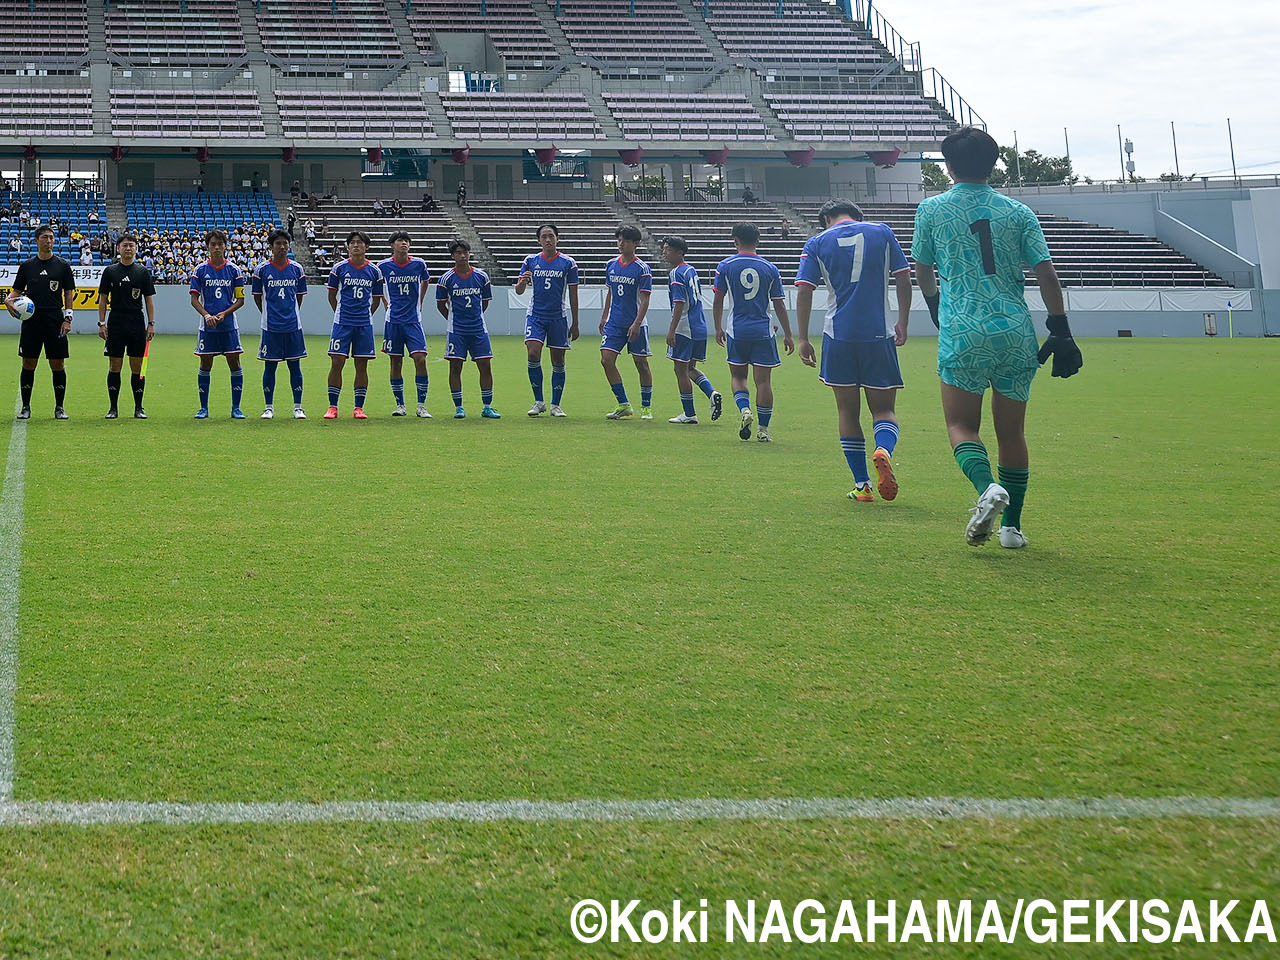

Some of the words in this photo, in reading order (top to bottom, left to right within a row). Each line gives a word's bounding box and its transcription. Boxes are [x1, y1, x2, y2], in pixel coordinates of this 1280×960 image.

[970, 218, 996, 274] 1
[836, 232, 864, 282] 7
[544, 278, 551, 289] 5
[740, 268, 760, 300] 9
[215, 288, 222, 298] 6
[278, 288, 285, 299] 4
[352, 286, 364, 298] 16
[398, 284, 409, 295] 14
[617, 284, 624, 296] 8
[466, 296, 472, 307] 2
[526, 327, 532, 336] 5
[198, 340, 204, 350] 6
[330, 339, 340, 350] 16
[383, 340, 392, 351] 14
[601, 335, 607, 345] 8
[262, 345, 268, 356] 4
[448, 343, 455, 355] 2
